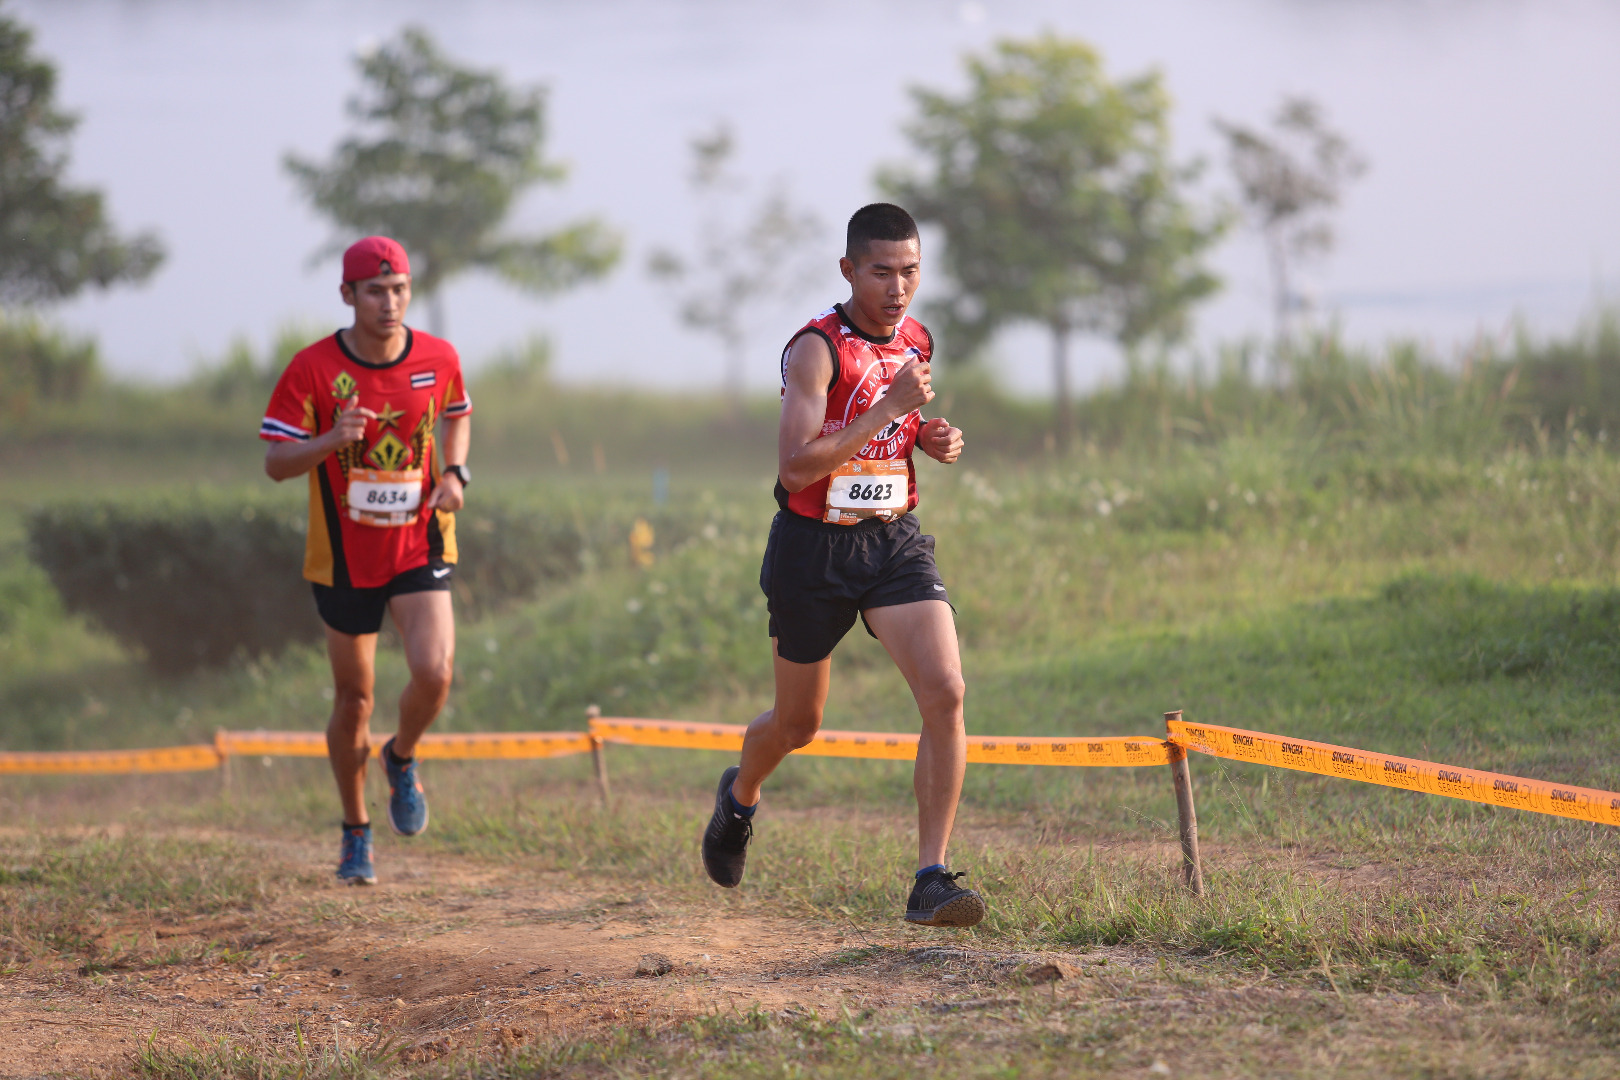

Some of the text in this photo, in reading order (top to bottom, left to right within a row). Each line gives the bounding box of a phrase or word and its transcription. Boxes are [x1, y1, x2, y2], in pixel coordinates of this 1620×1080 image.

[366, 489, 408, 505] 8634
[848, 483, 893, 501] 8623
[1232, 733, 1254, 747] SINGHA
[1234, 745, 1257, 759] SERIES
[1281, 742, 1304, 755] SINGHA
[1282, 753, 1306, 767] SERIES
[1331, 751, 1355, 765] SINGHA
[1332, 762, 1357, 777] SERIES
[1383, 760, 1408, 775] SINGHA
[1384, 772, 1410, 786] SERIES
[1436, 769, 1462, 784] SINGHA
[1437, 781, 1464, 796] SERIES
[1492, 779, 1519, 794] SINGHA
[1493, 791, 1521, 806] SERIES
[1550, 788, 1577, 803] SINGHA
[1551, 801, 1579, 816] SERIES
